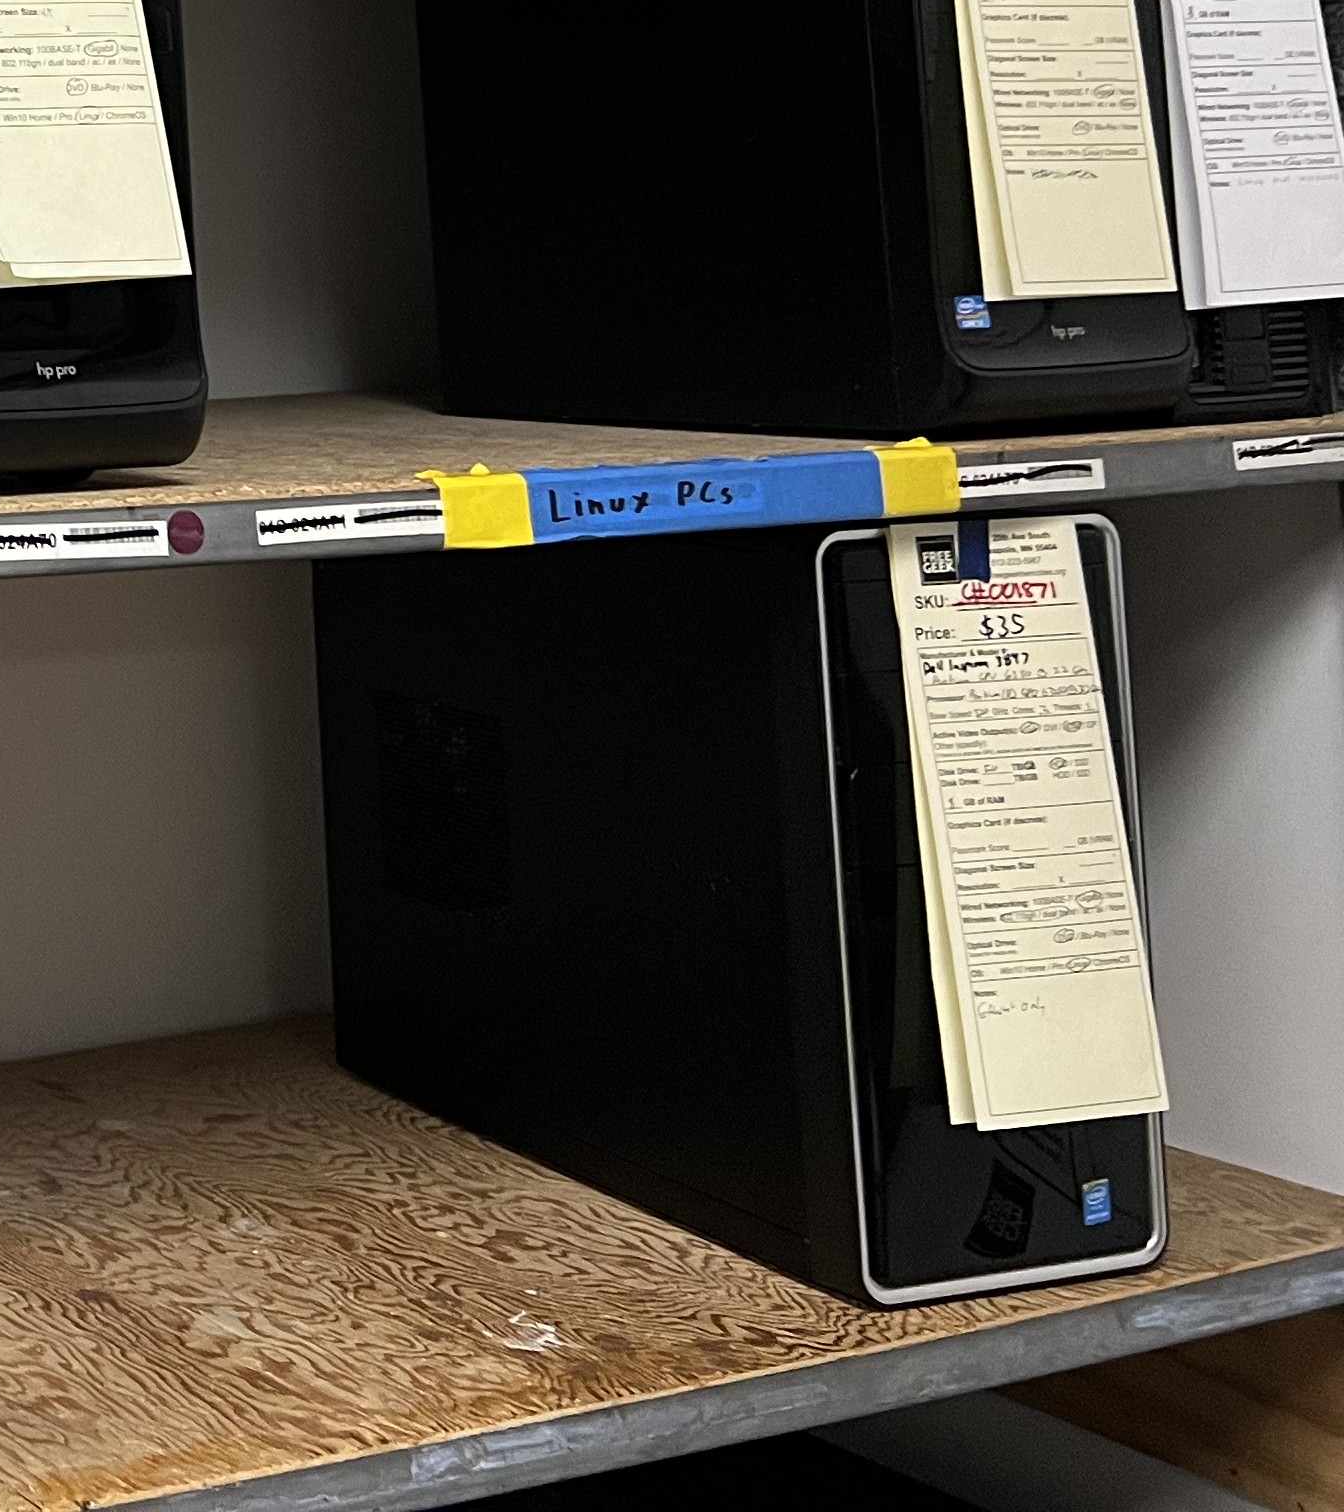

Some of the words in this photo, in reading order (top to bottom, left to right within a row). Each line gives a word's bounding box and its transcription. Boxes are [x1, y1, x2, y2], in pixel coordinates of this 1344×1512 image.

[36, 361, 53, 379] hp
[56, 365, 76, 379] pro
[549, 489, 652, 523] Linux
[677, 482, 735, 508] PCs
[922, 551, 952, 562] FREE
[923, 562, 954, 573] GEEK
[914, 596, 948, 609] SKU:
[915, 627, 956, 639] Price:
[979, 614, 1024, 639] $35
